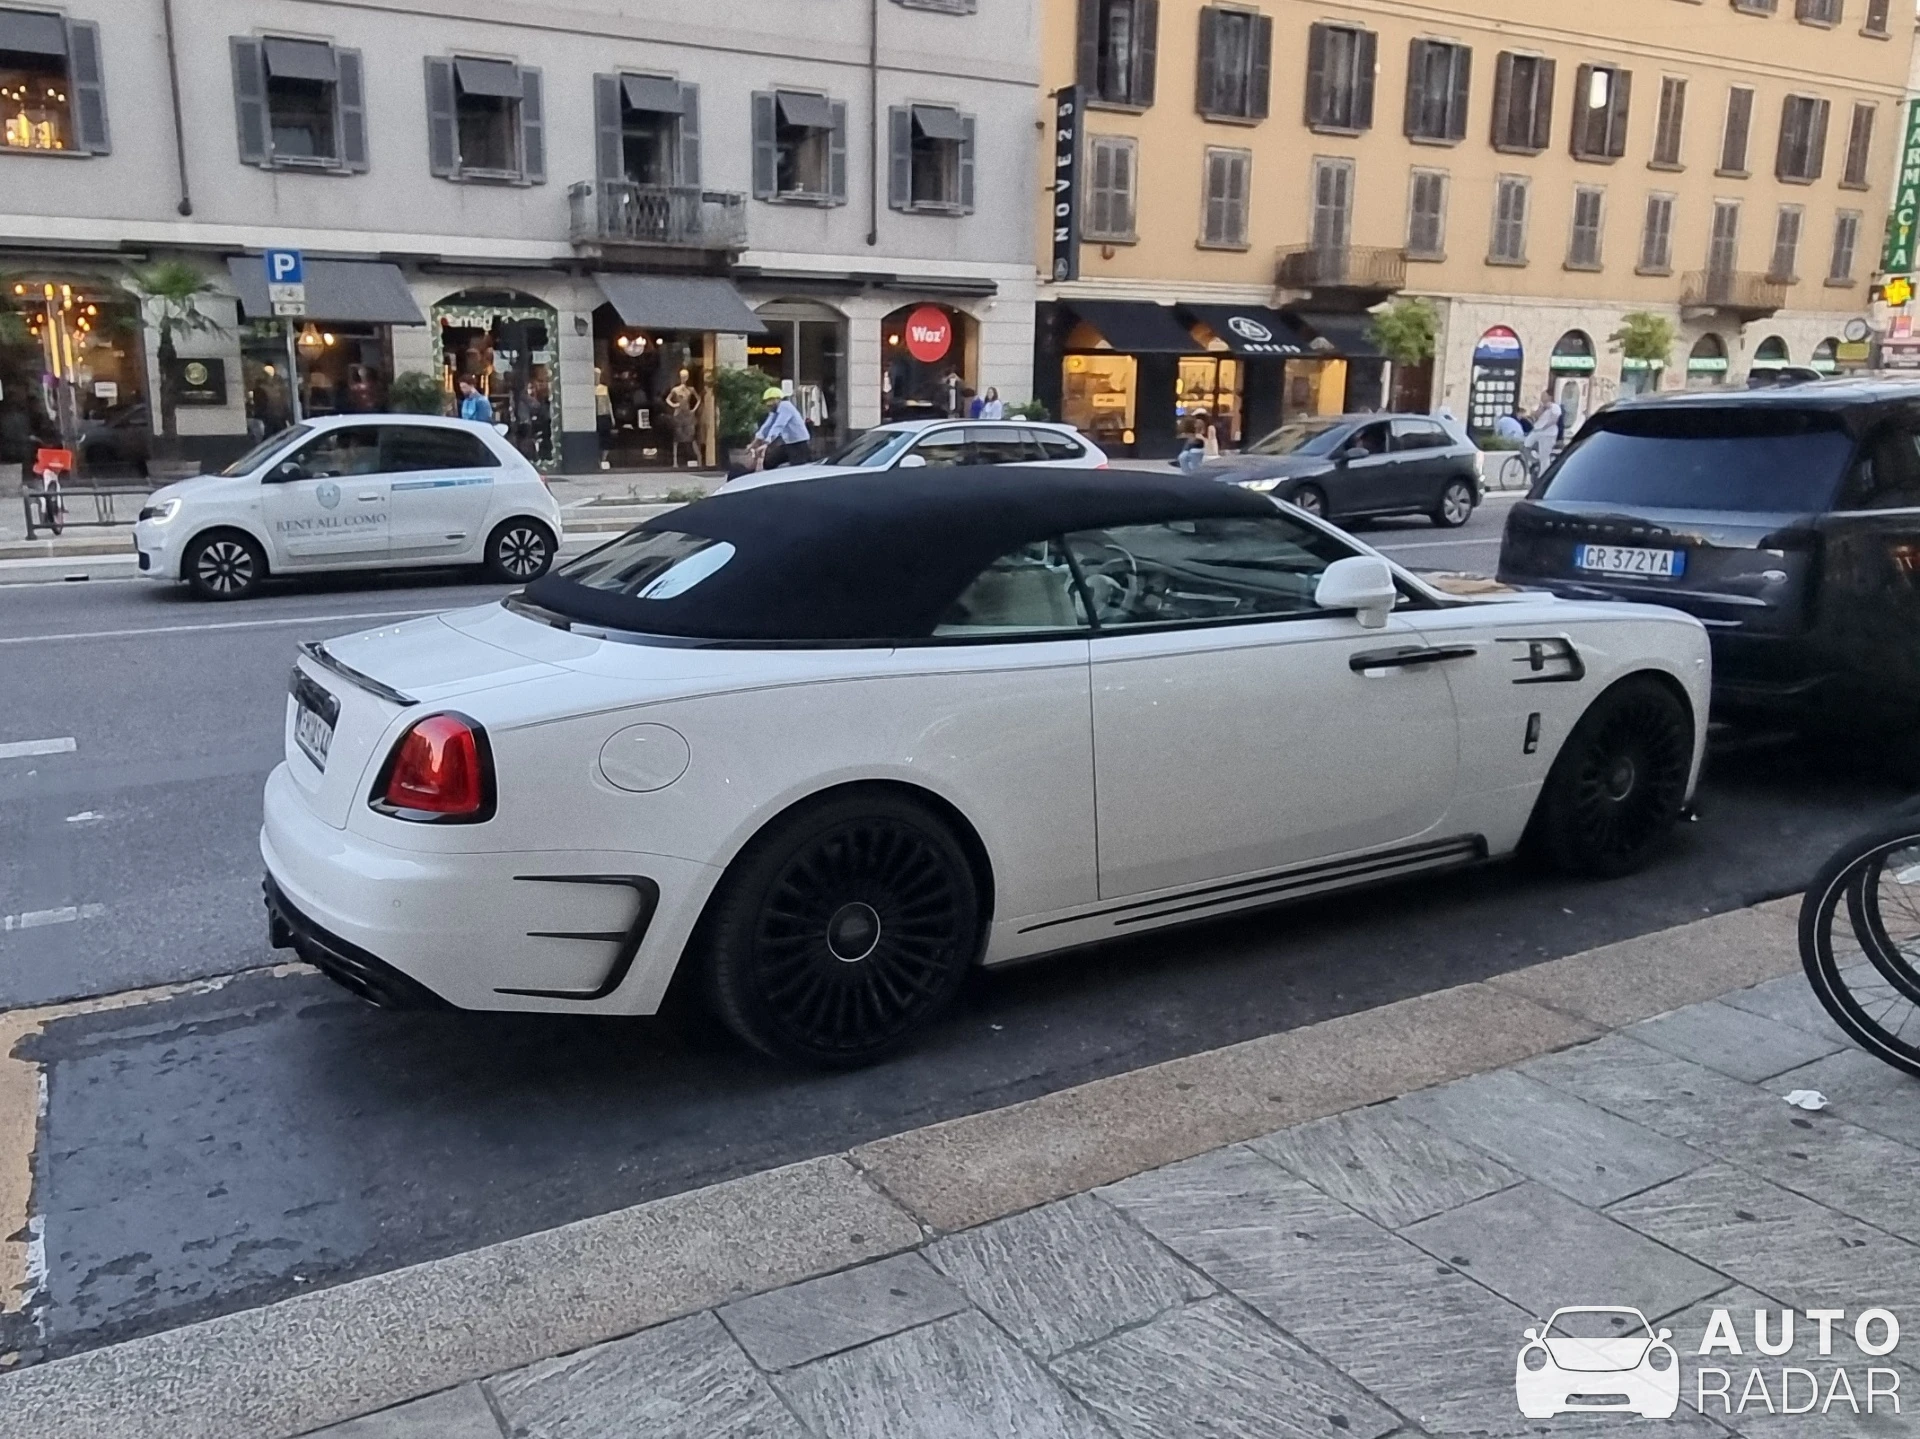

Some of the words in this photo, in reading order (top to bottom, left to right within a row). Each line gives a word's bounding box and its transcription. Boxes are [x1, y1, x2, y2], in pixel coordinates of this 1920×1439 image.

[1890, 106, 1920, 266] ARMACIA
[273, 253, 295, 280] P
[276, 518, 315, 532] RENT
[317, 516, 342, 529] ALL
[344, 513, 386, 527] COMO
[1585, 547, 1607, 568] GR
[1612, 549, 1669, 573] 372YA
